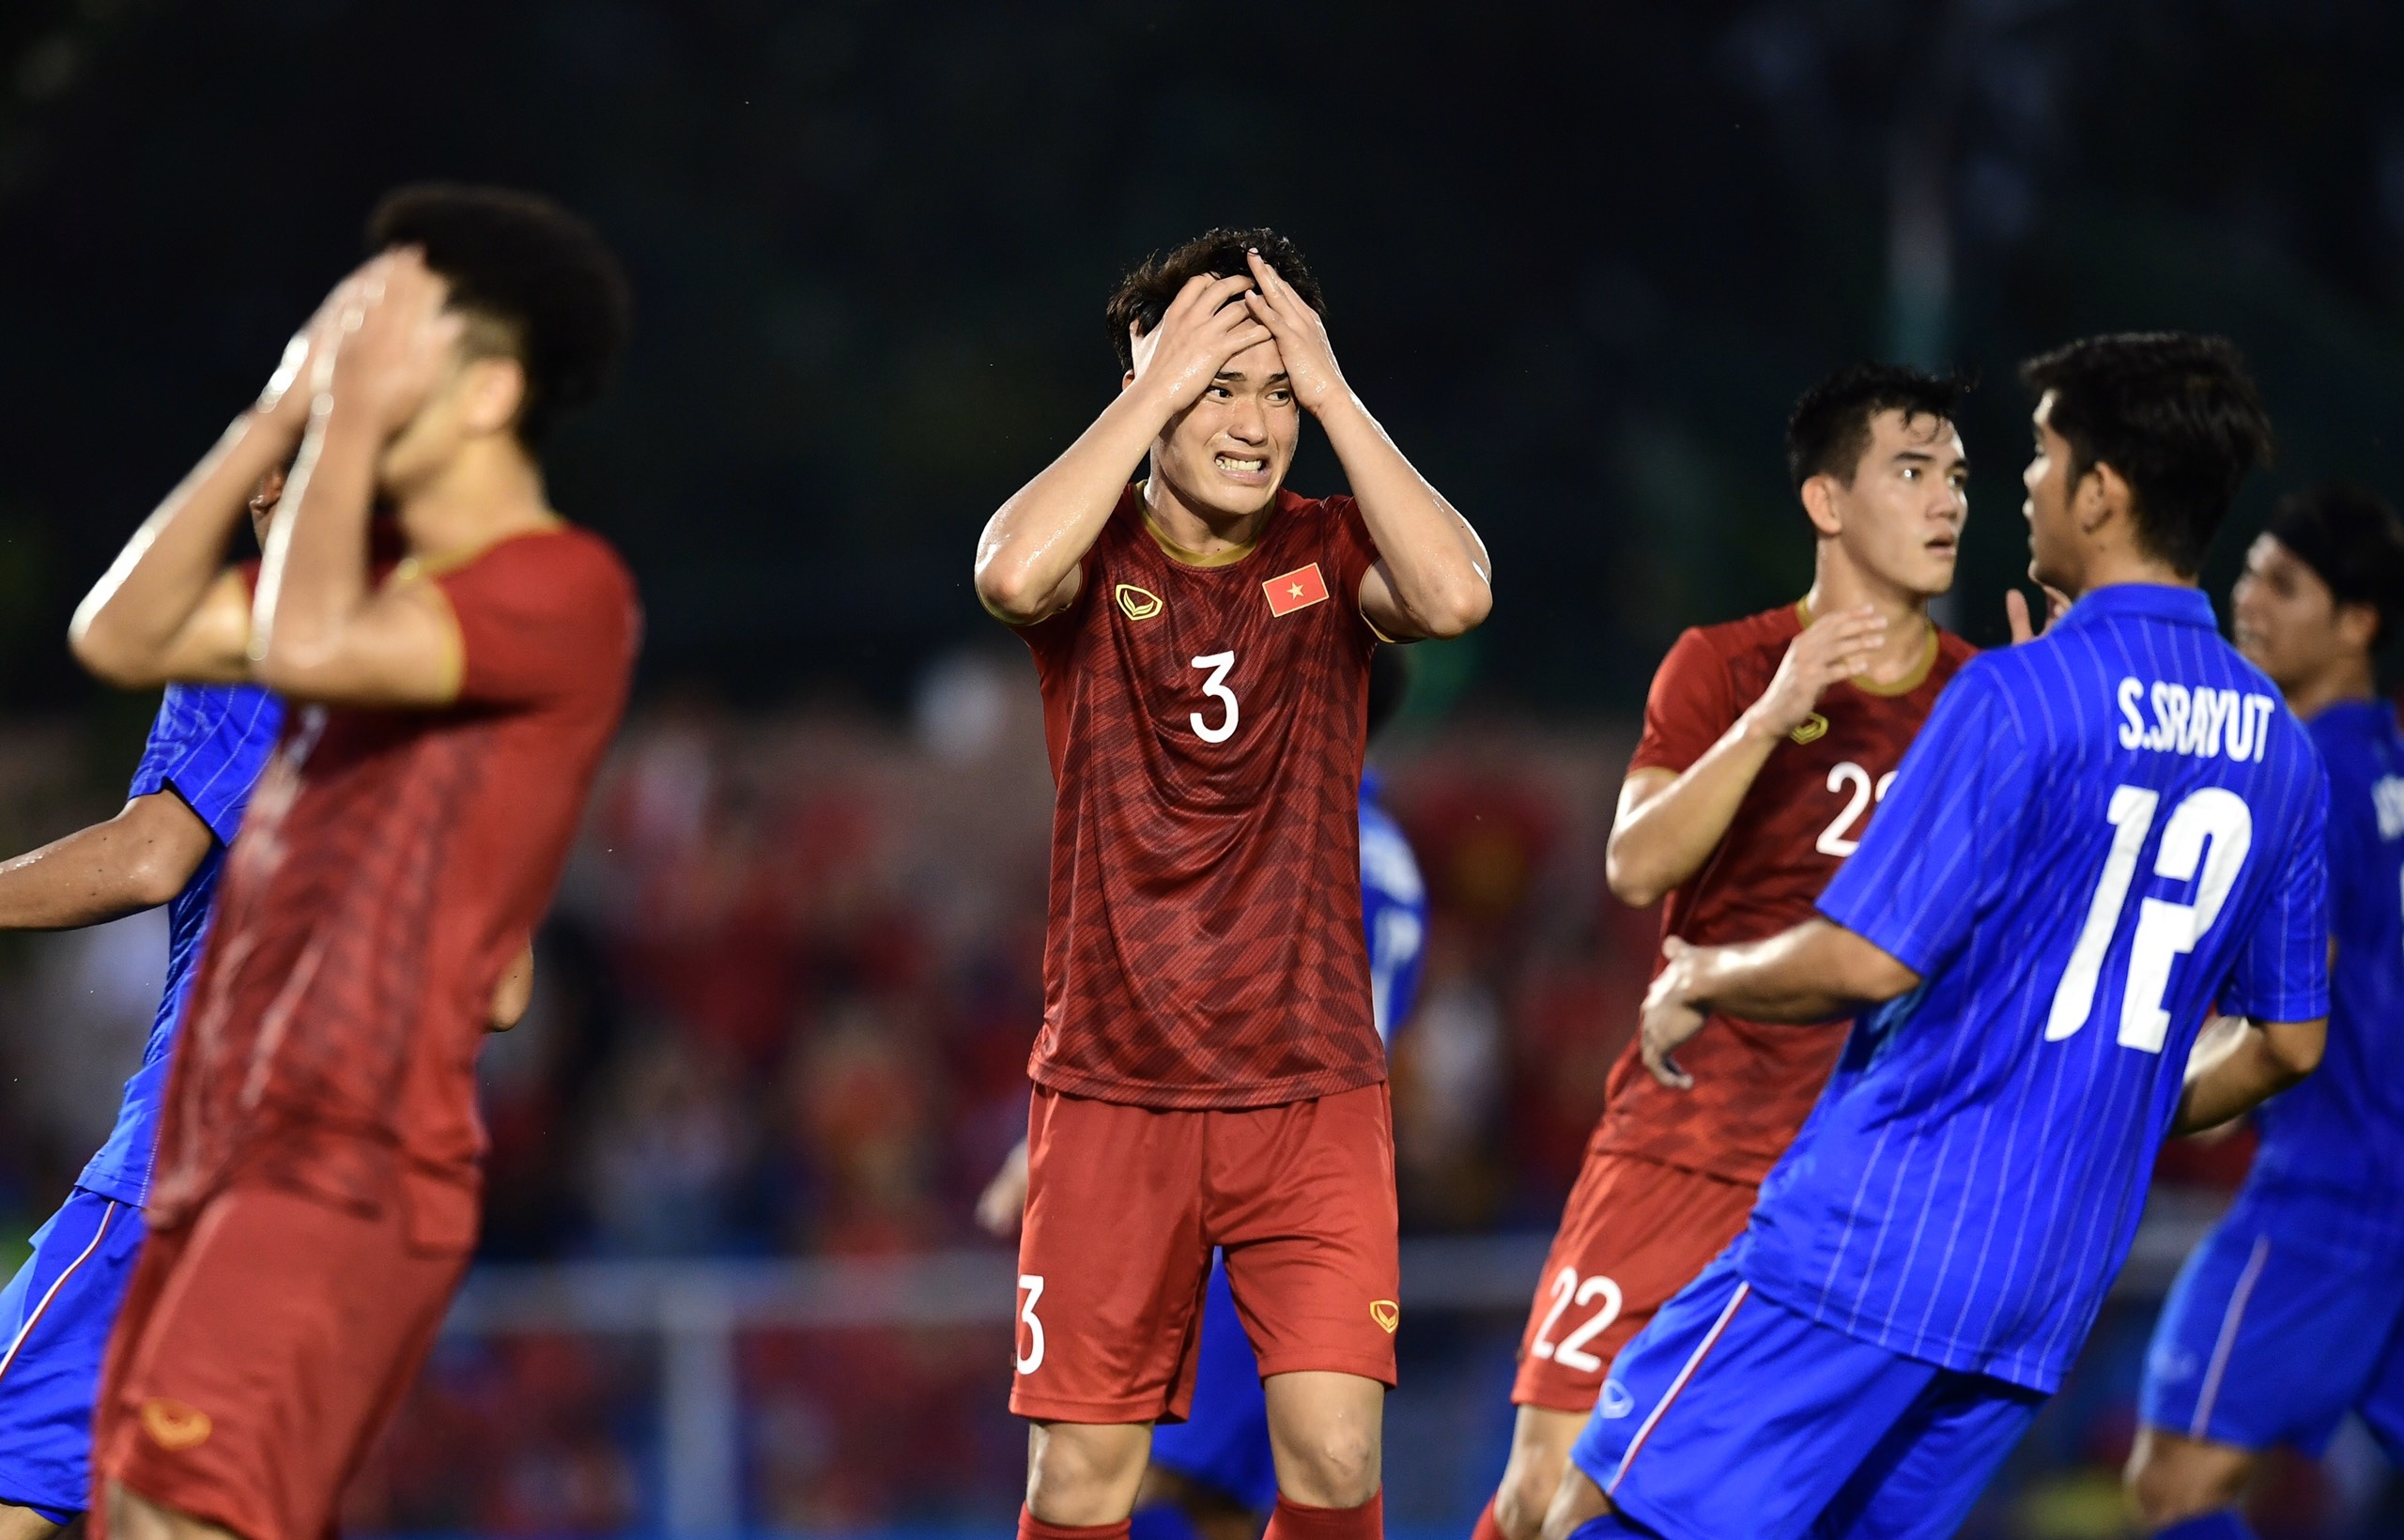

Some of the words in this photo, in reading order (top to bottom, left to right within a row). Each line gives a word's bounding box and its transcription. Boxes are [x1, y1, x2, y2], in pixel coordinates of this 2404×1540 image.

[1190, 651, 1239, 743] 3
[2118, 677, 2274, 762] S.SRAYUT
[2045, 786, 2253, 1054] 12
[1017, 1274, 1044, 1375] 3
[1532, 1266, 1623, 1373] 22
